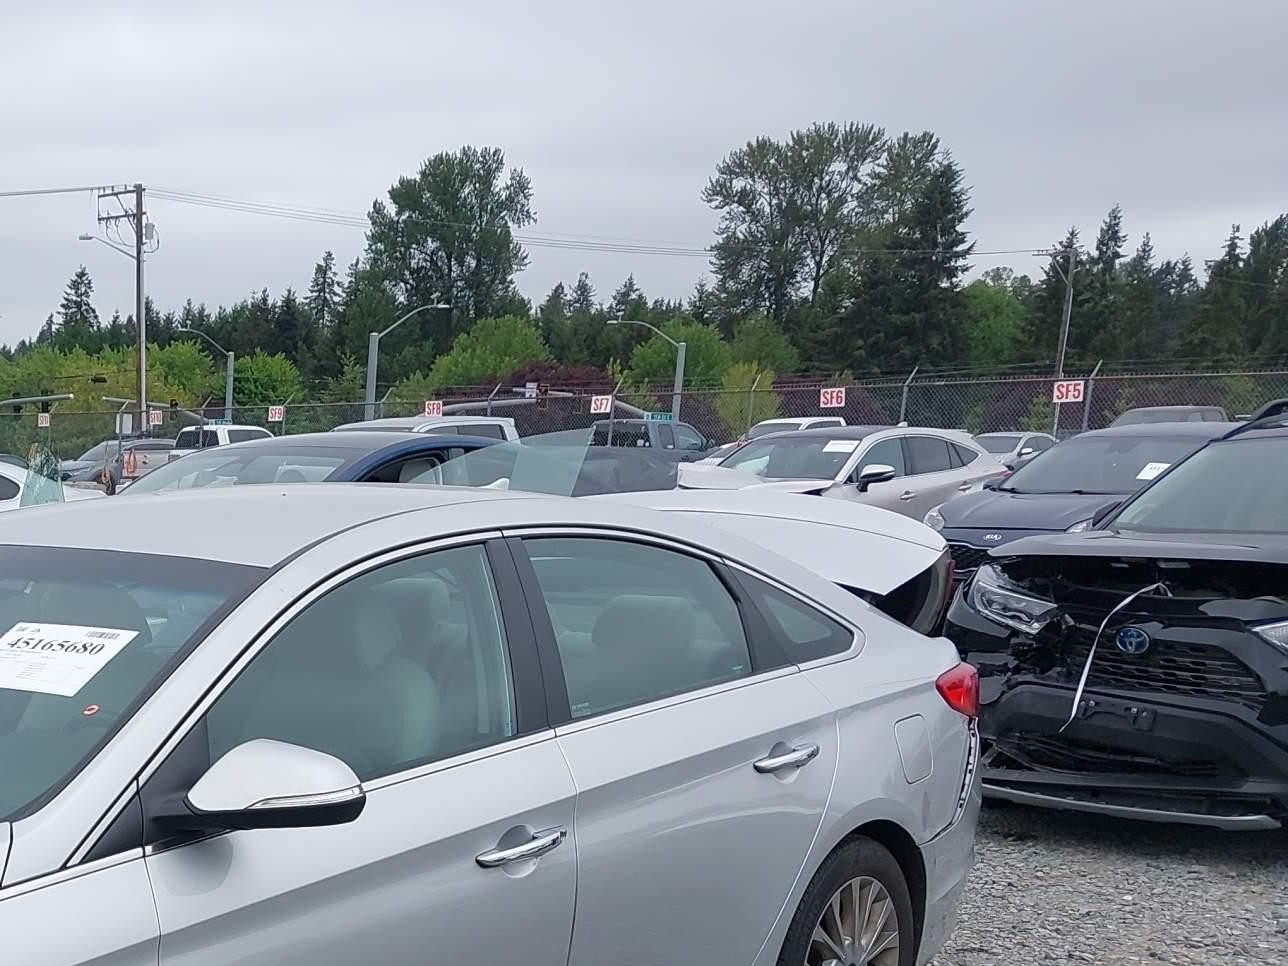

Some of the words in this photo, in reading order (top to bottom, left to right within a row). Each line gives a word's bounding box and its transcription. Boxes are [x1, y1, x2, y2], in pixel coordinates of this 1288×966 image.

[822, 390, 843, 406] SF6
[1056, 383, 1081, 400] SF5
[427, 402, 441, 415] SF8
[593, 398, 609, 411] SF7
[270, 408, 283, 419] SF9
[7, 637, 105, 656] 45165680
